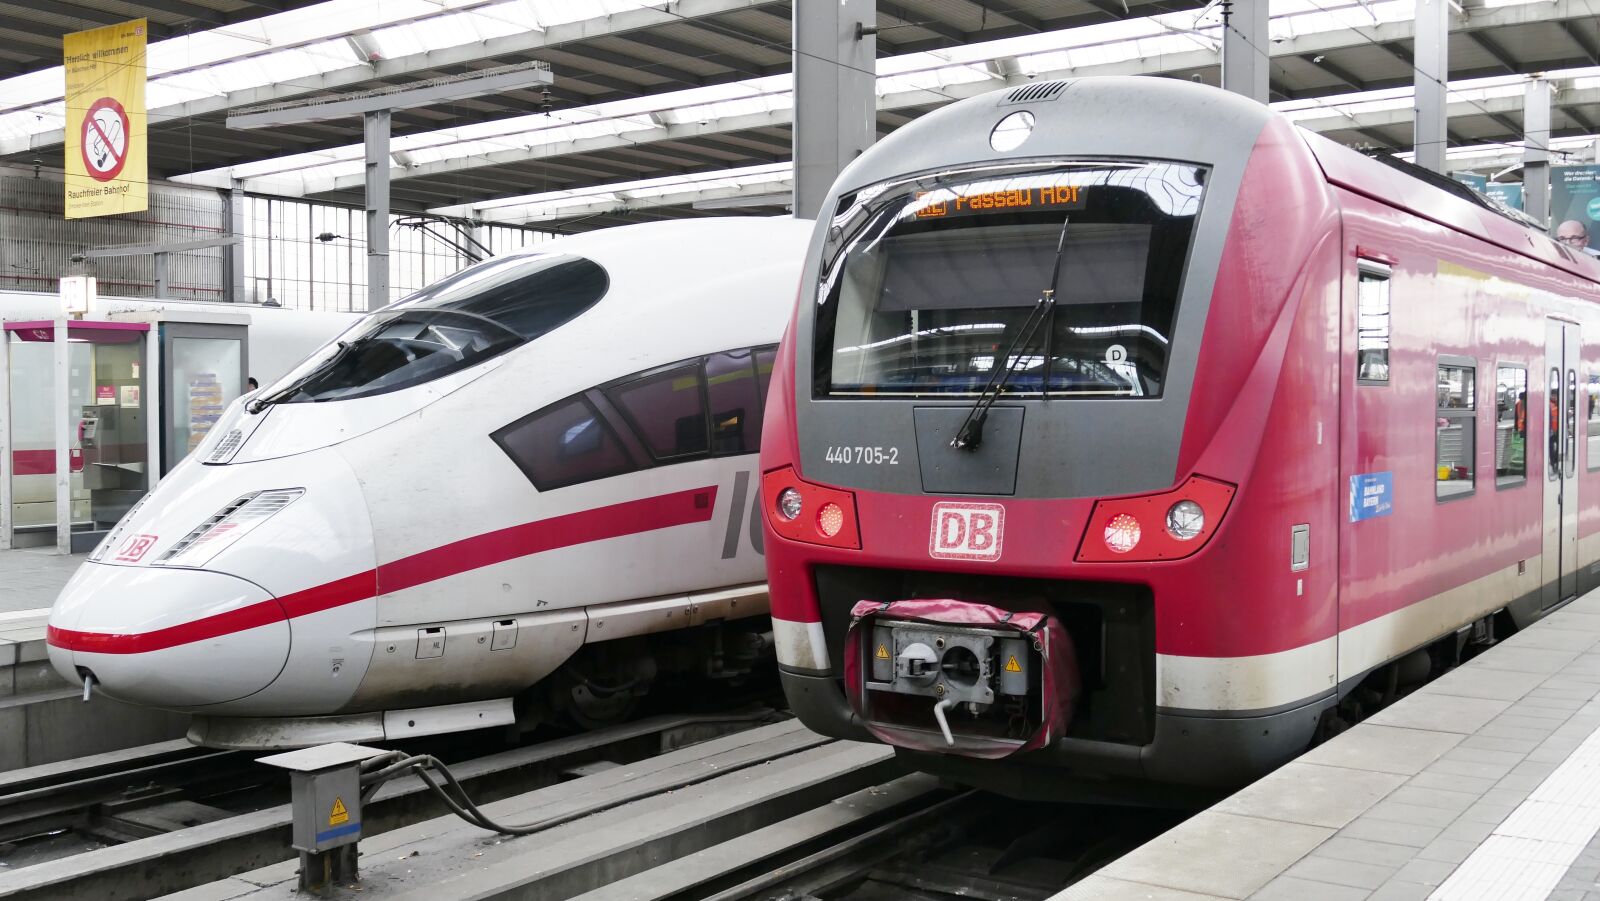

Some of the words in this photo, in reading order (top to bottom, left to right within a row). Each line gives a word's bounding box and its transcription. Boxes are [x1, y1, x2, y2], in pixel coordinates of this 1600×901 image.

[92, 46, 129, 59] willkommen
[67, 188, 102, 199] Rauchfreier
[104, 184, 130, 195] Bahnhof
[956, 187, 1031, 210] Passau
[1112, 350, 1121, 361] D
[825, 447, 852, 464] 440
[855, 447, 899, 465] 705-2
[939, 511, 994, 551] DB
